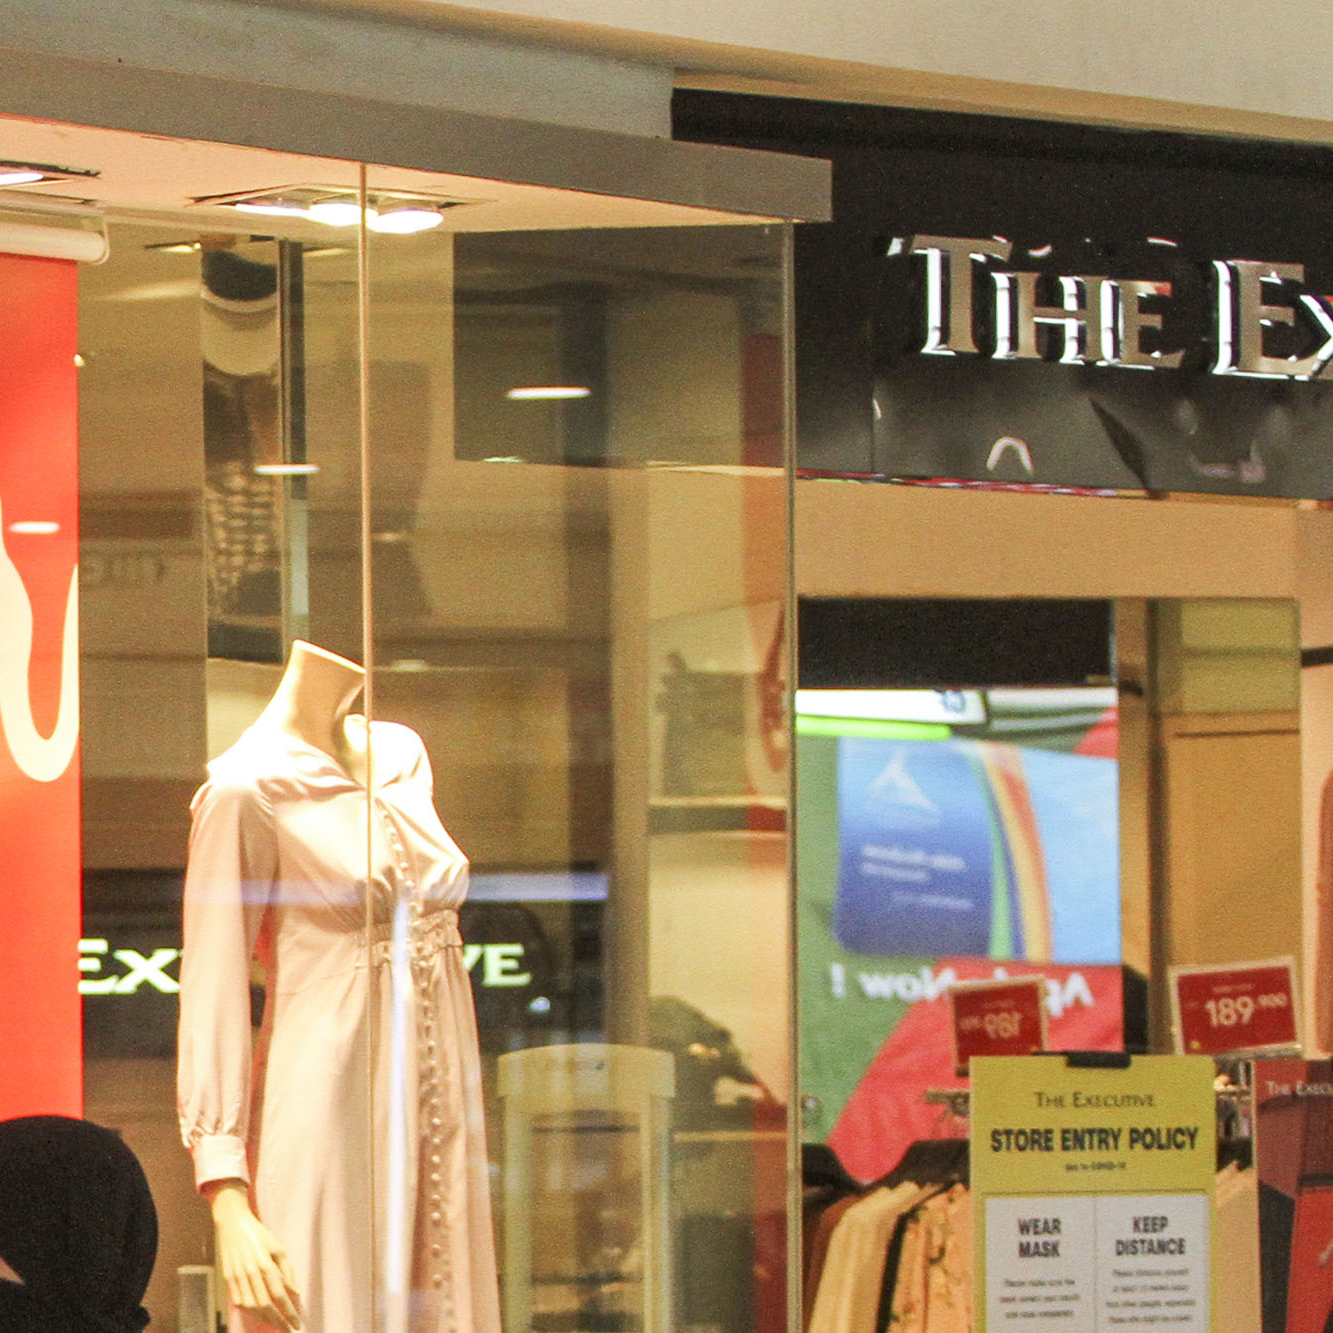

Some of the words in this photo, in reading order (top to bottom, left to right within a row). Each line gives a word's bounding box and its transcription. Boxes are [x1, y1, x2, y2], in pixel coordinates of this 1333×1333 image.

[889, 234, 1186, 370] THE
[1034, 1092, 1065, 1108] THE
[991, 1128, 1054, 1152] STORE
[1061, 1127, 1121, 1151] ENTRY
[1129, 1126, 1200, 1150] POLICY
[1018, 1218, 1061, 1236] WEAR
[1132, 1216, 1168, 1233] KEEP
[1018, 1241, 1060, 1258] MASK
[1115, 1238, 1186, 1256] DISTANCE
